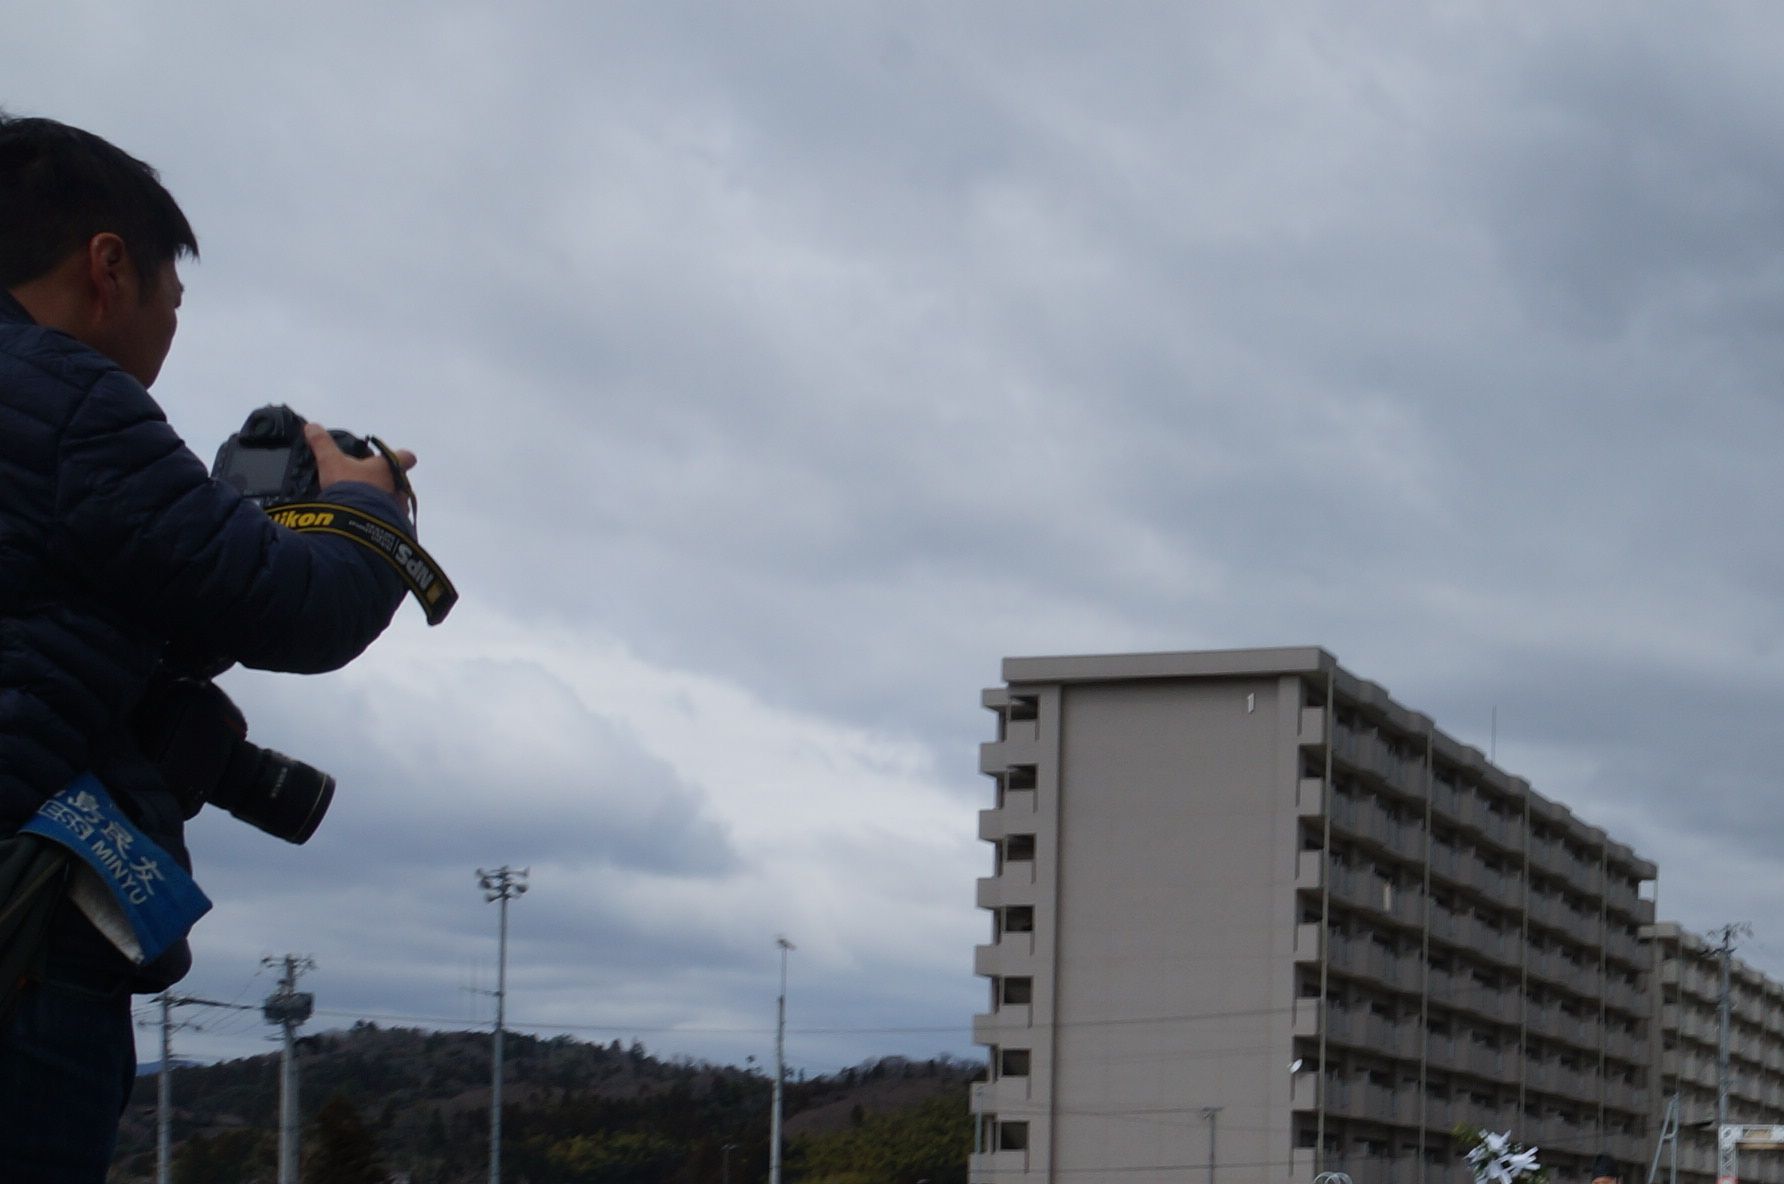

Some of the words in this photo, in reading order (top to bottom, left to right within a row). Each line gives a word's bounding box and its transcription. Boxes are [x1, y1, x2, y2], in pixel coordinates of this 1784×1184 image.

[395, 543, 434, 590] NPS
[54, 790, 165, 896] 島民友
[91, 840, 147, 905] MINYU
